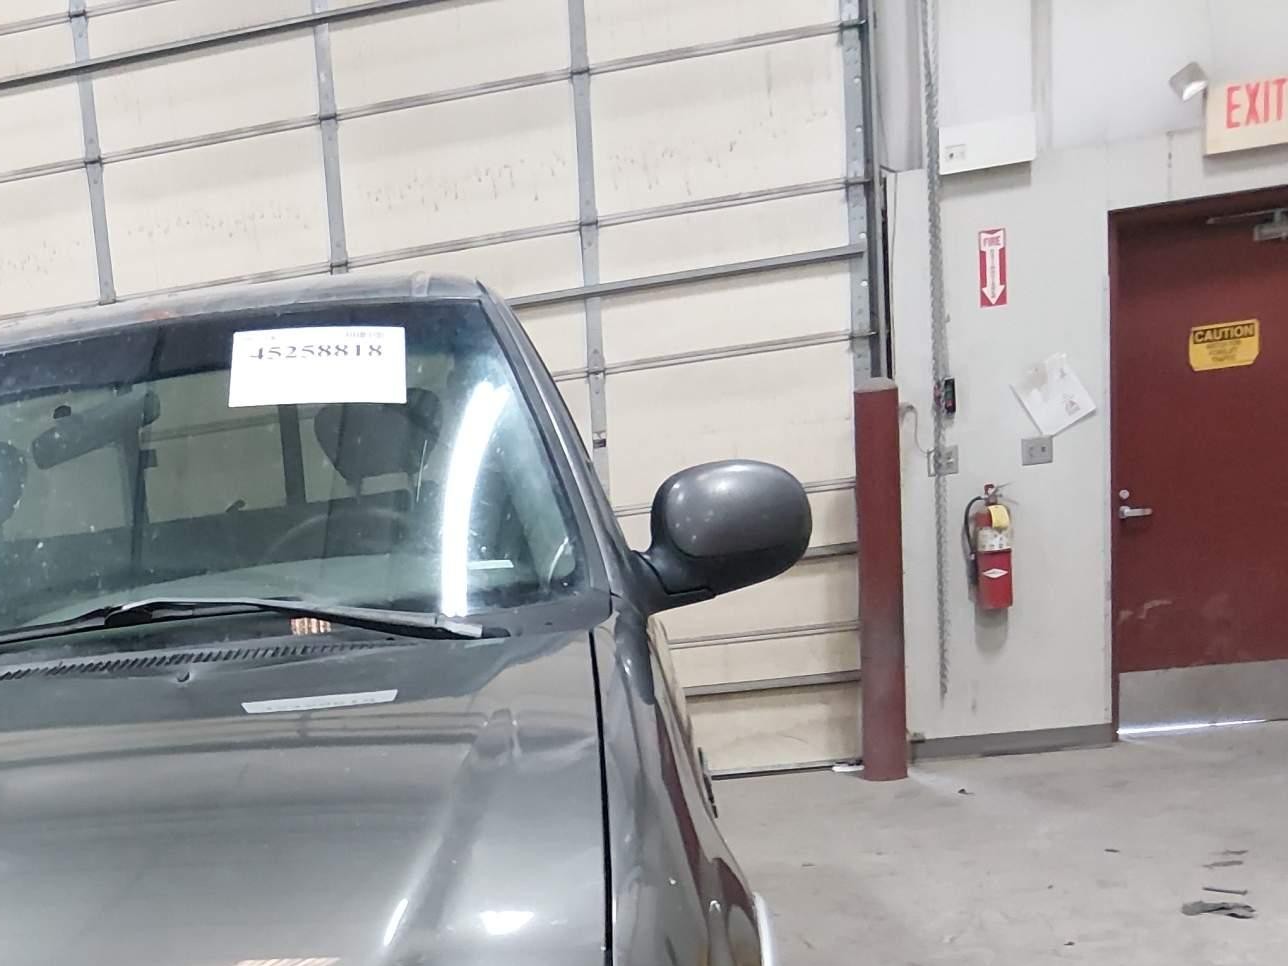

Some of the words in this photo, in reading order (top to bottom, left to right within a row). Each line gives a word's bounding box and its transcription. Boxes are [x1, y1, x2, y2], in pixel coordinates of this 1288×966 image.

[1226, 78, 1287, 129] EXIT
[1194, 324, 1254, 343] CAUTION
[248, 344, 382, 360] 45258818
